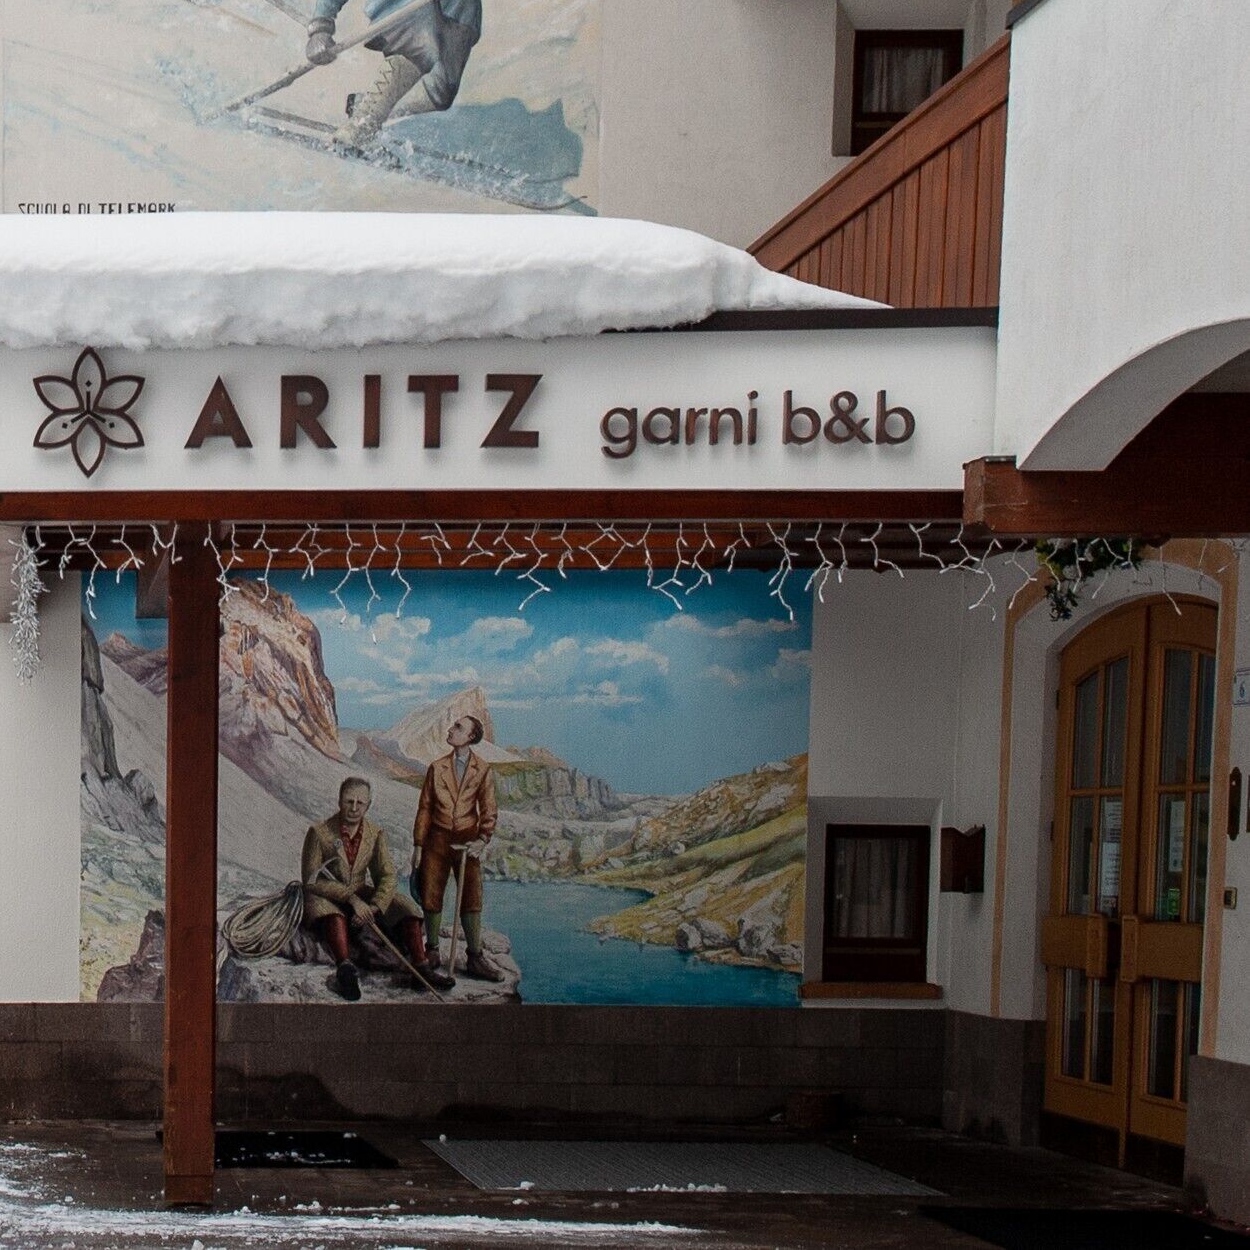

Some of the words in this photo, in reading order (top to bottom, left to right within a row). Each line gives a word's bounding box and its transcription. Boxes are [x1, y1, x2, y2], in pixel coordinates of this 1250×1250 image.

[98, 203, 176, 214] TELEMARK
[183, 373, 543, 449] ARITZ
[600, 391, 759, 458] garni
[783, 390, 916, 446] b&b
